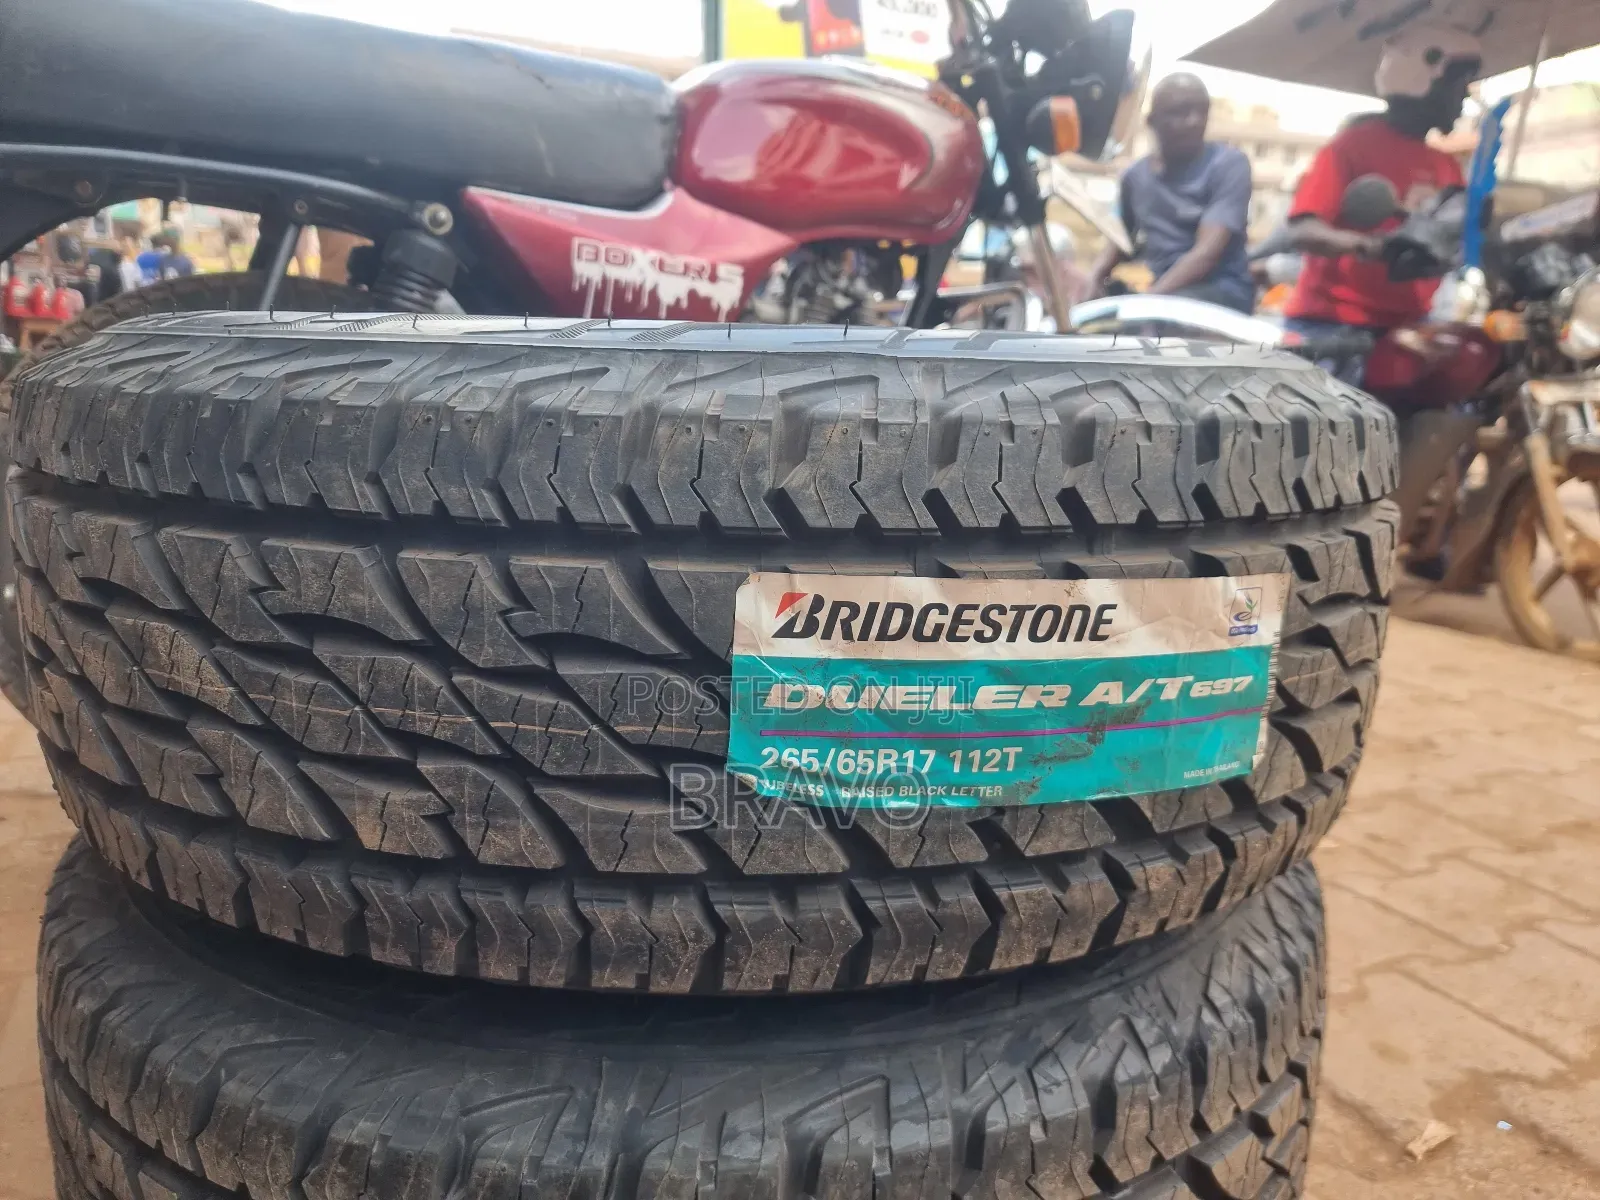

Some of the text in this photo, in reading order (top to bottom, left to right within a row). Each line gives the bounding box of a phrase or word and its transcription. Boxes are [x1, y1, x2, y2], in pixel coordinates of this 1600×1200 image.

[771, 592, 1117, 643] BRIDGESTONE
[762, 684, 1071, 711] DUELER
[760, 747, 1023, 775] 265/65R17 112T
[840, 786, 895, 798] RAISED
[898, 785, 946, 797] BLACK
[951, 785, 1003, 797] LETTER
